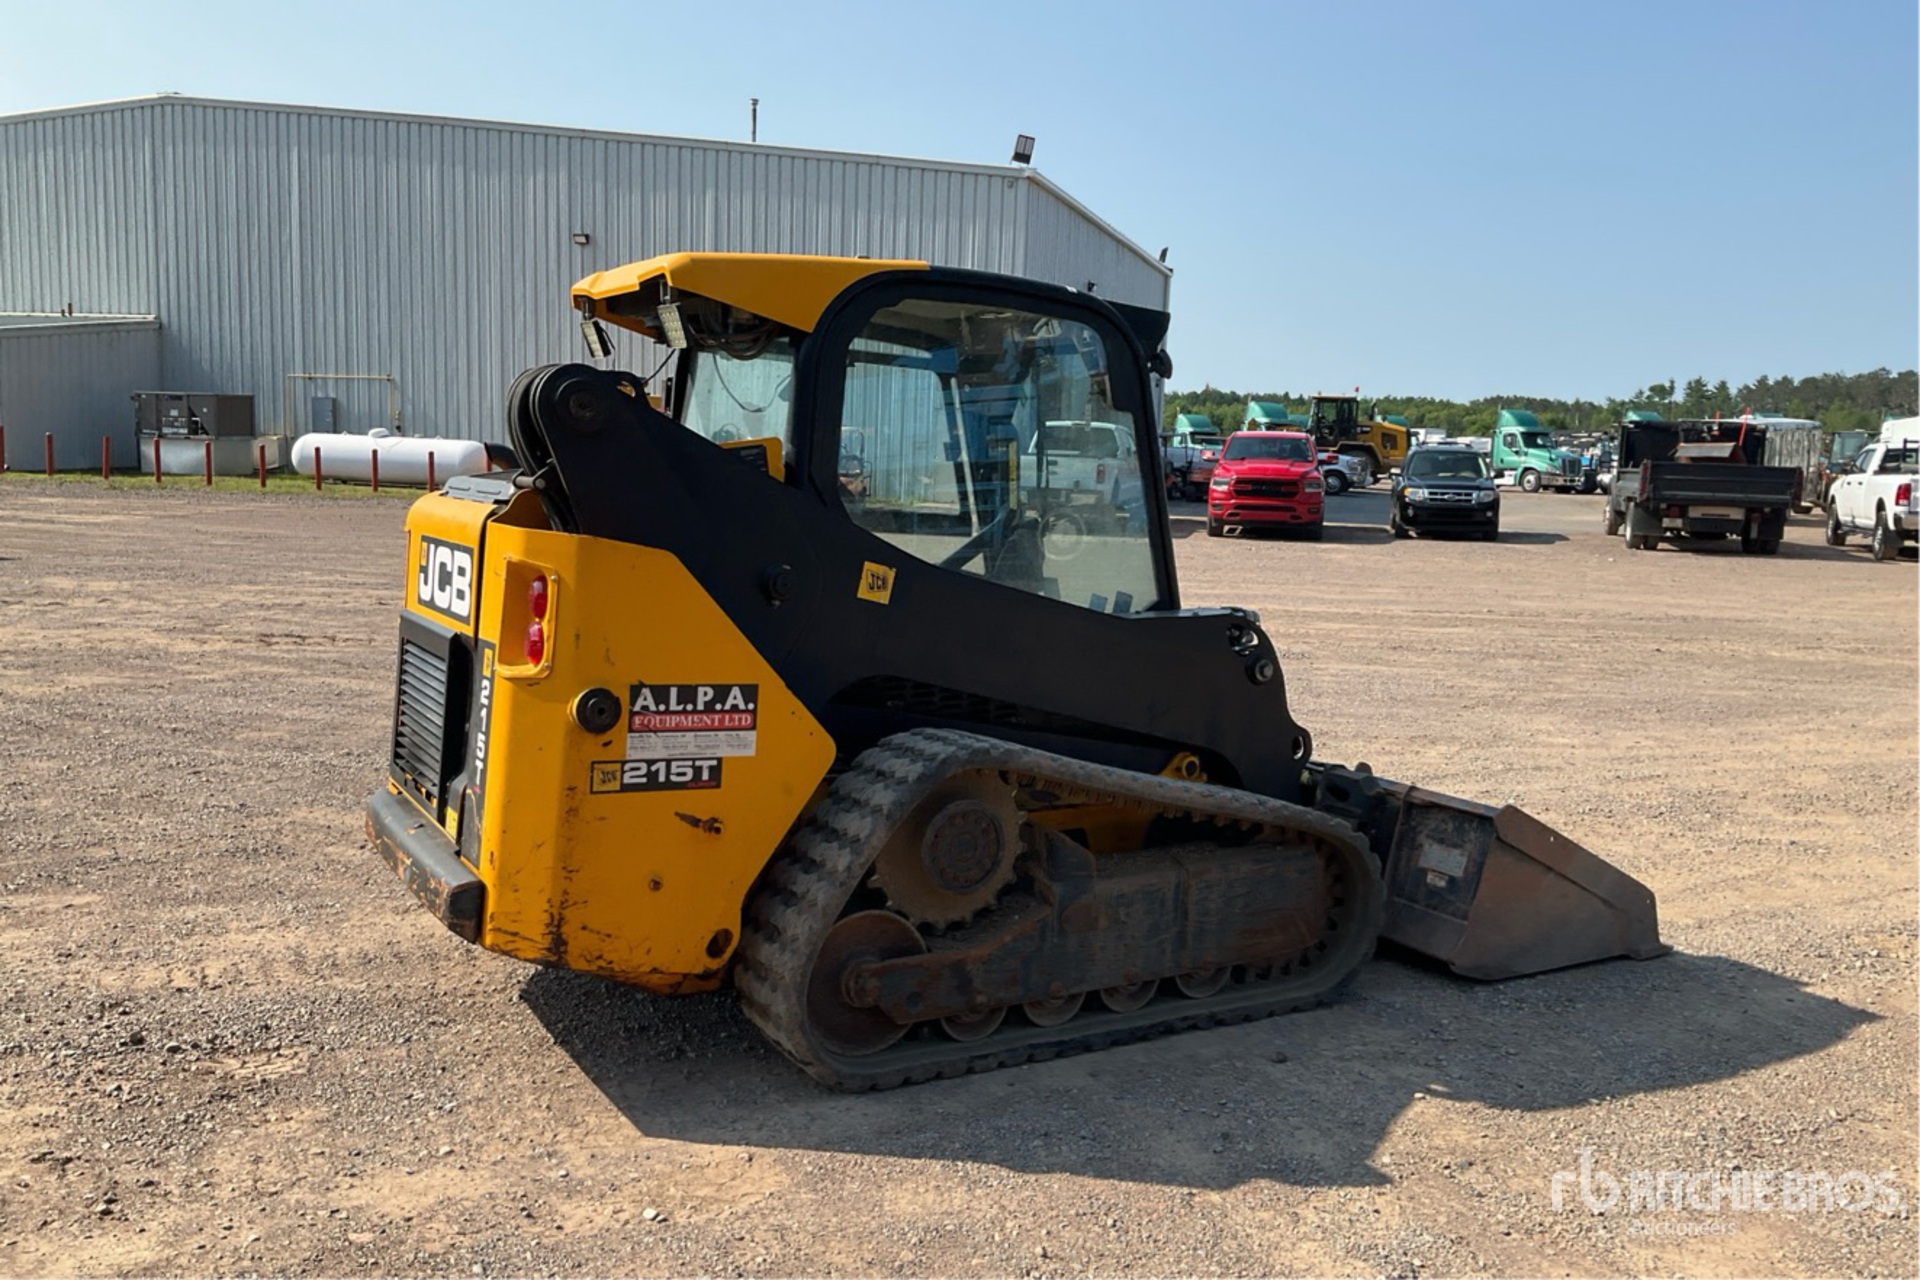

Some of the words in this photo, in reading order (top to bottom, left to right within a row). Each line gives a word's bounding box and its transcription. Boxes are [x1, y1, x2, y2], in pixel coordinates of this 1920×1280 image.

[418, 543, 472, 617] JCB
[868, 572, 888, 591] JCB
[633, 686, 755, 712] A.L.P.A.
[634, 714, 723, 729] EQUIPMENT
[724, 713, 752, 727] LTD
[622, 759, 718, 784] 215T
